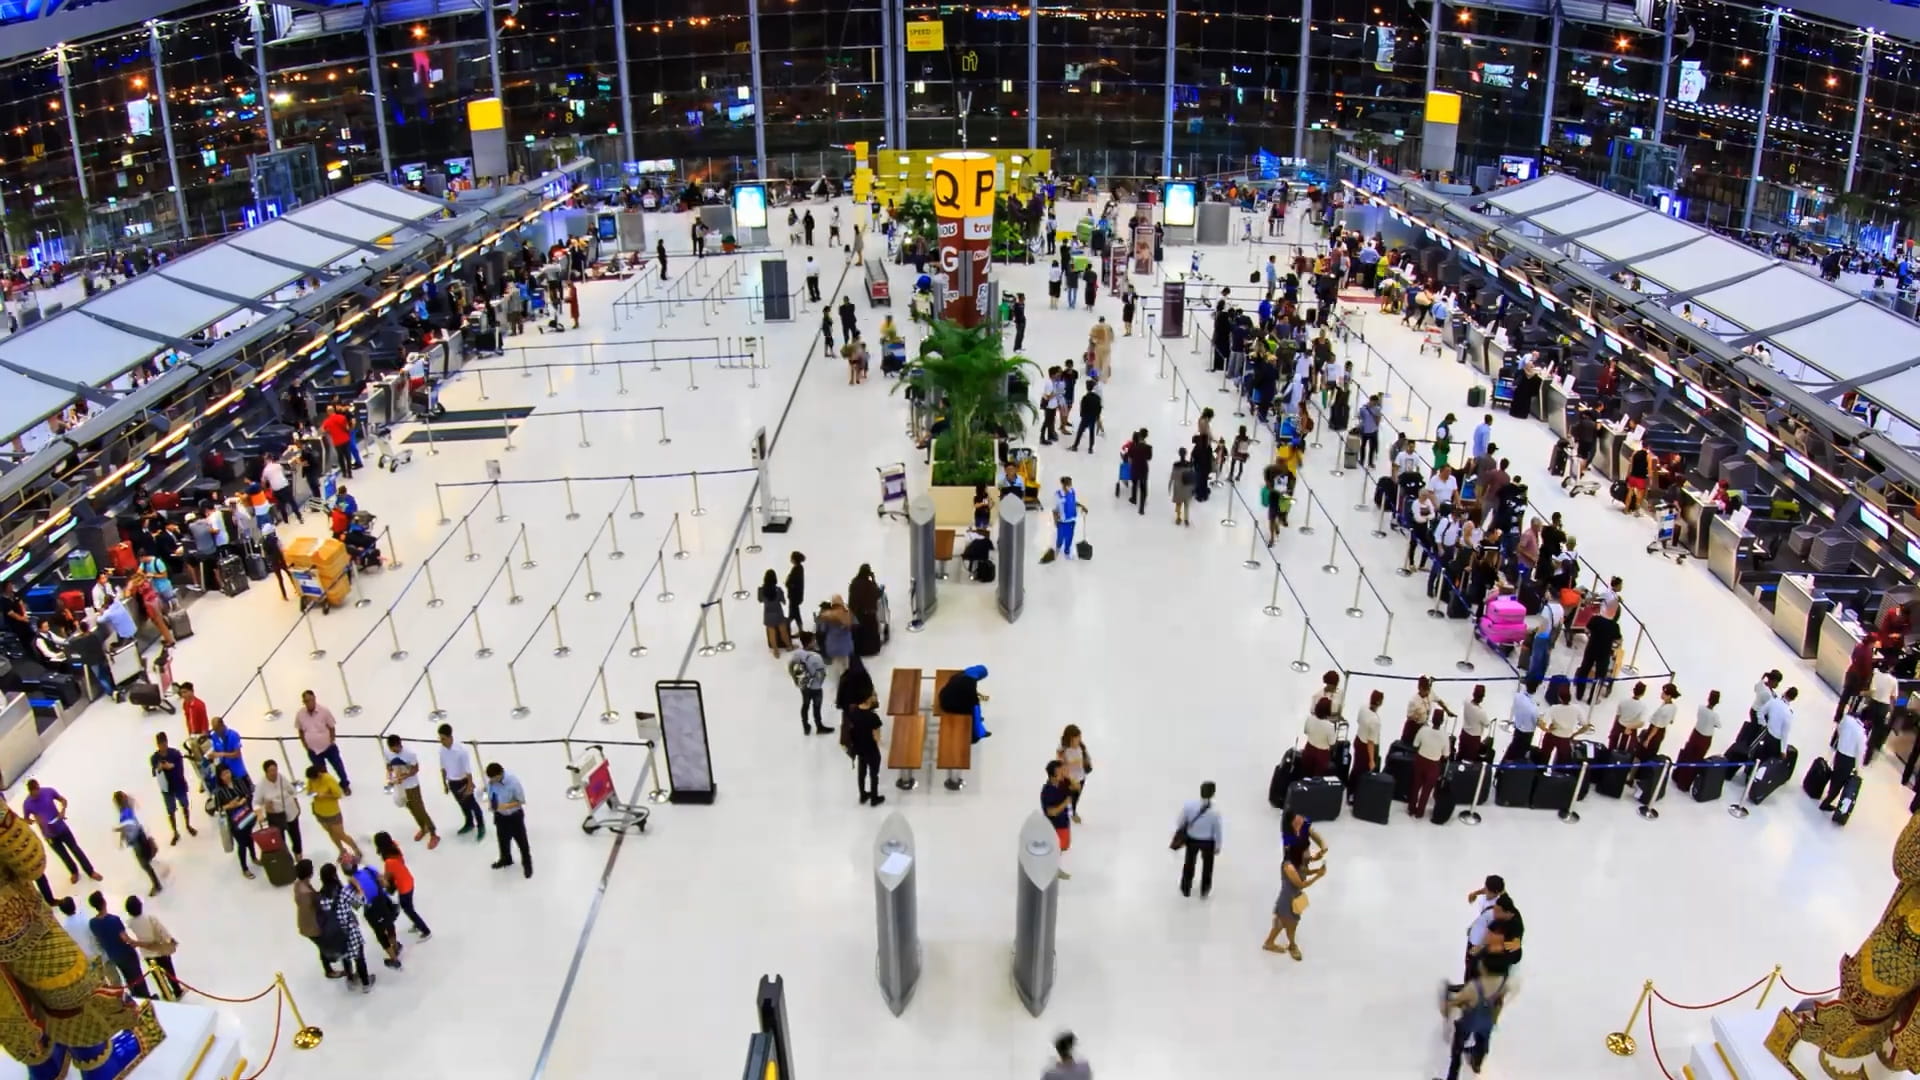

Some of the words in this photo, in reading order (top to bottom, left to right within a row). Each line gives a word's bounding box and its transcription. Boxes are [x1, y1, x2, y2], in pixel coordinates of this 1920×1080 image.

[565, 112, 573, 123] 8
[1355, 106, 1364, 118] 7
[1788, 163, 1796, 174] 6
[136, 174, 144, 185] 9
[935, 170, 960, 210] Q
[975, 170, 994, 207] P
[942, 246, 958, 272] G
